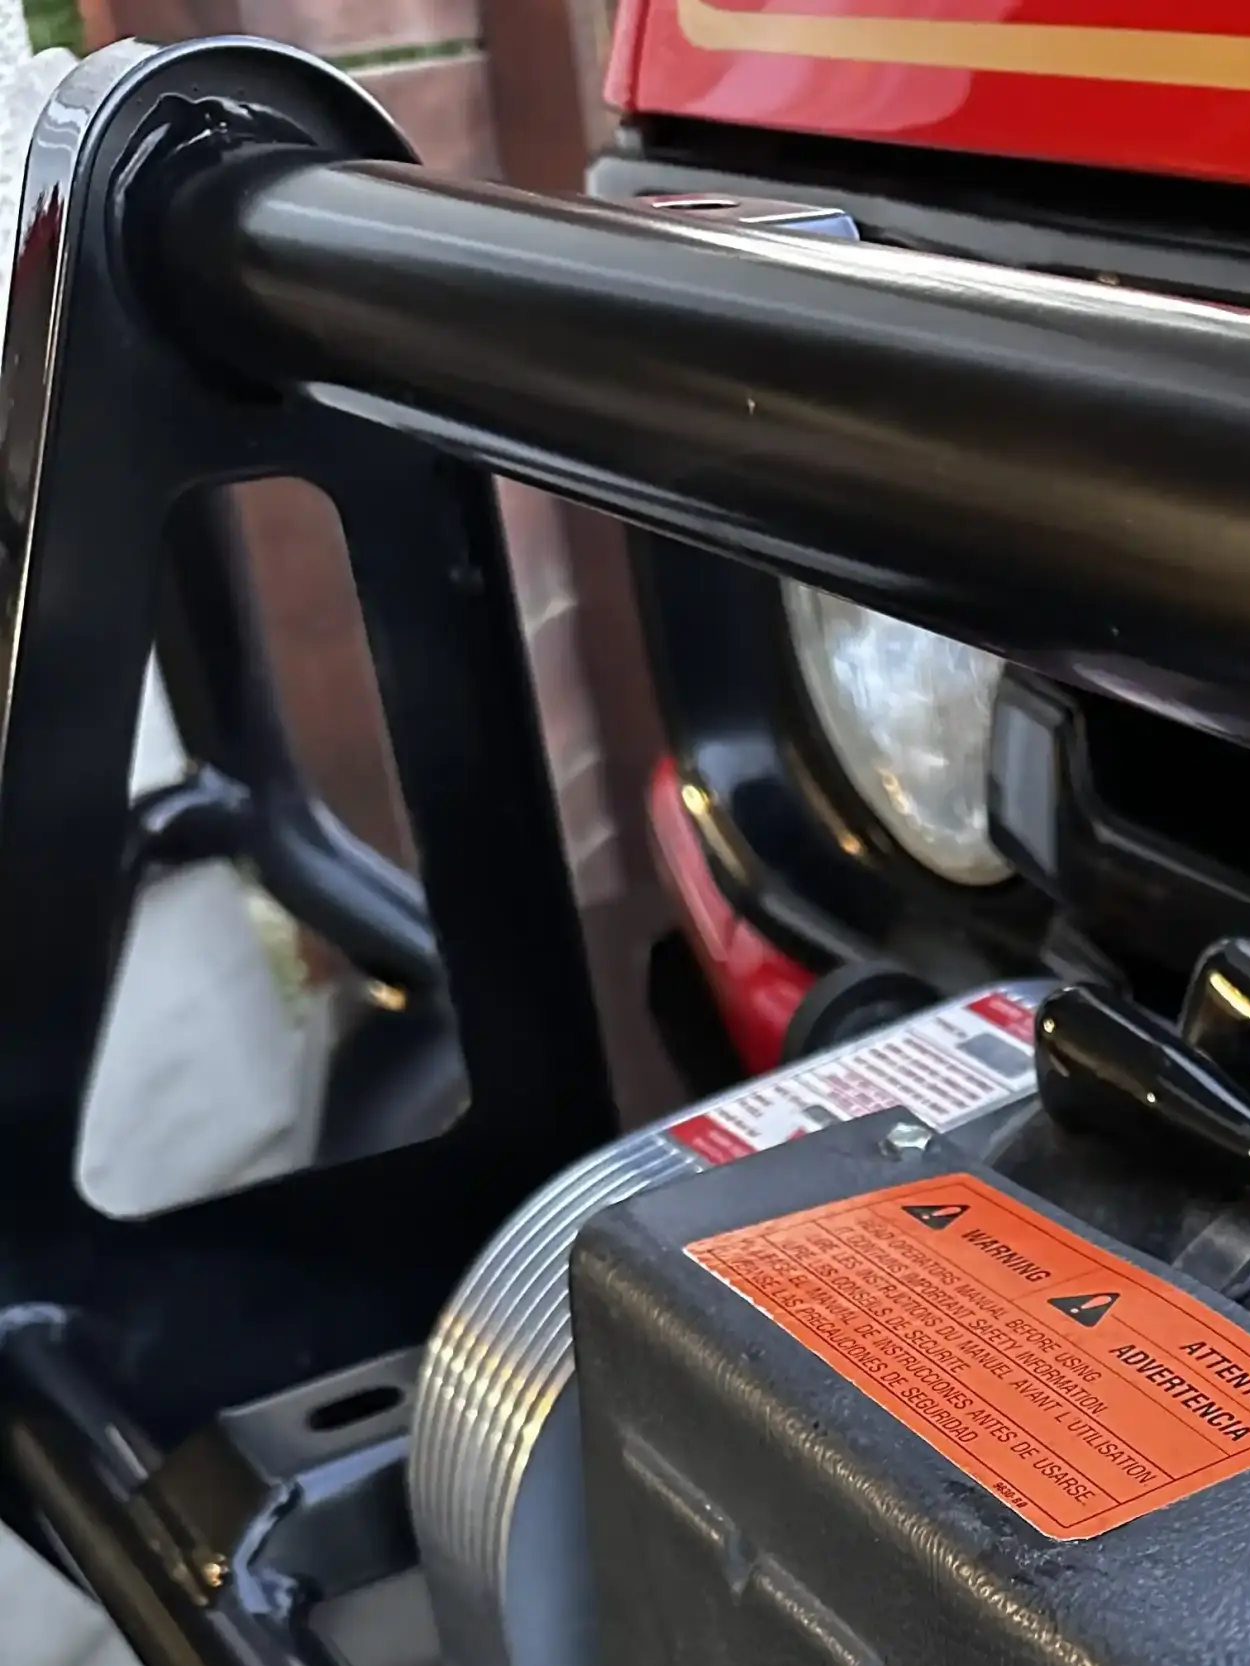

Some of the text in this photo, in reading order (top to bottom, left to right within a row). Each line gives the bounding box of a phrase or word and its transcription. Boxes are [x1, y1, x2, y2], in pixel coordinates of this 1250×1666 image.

[807, 1260, 838, 1277] LES
[831, 1276, 893, 1317] CONSEILS
[886, 1316, 910, 1329] DE
[831, 1252, 863, 1269] LES
[936, 1326, 962, 1340] DU
[957, 1341, 1015, 1378] MANUEL
[1010, 1379, 1061, 1412] AVANT
[847, 1235, 908, 1272] CONTAINS
[901, 1272, 974, 1318] IMPORTANT
[968, 1319, 1020, 1351] SAFETY
[1015, 1351, 1110, 1415] INFORMATION.
[888, 1240, 960, 1284] OPERATORS
[954, 1284, 1010, 1318] MANUAL
[1007, 1319, 1059, 1352] BEFORE
[1054, 1352, 1101, 1381] USING
[960, 1229, 1052, 1281] WARNING
[772, 1288, 803, 1307] LAS
[796, 1307, 888, 1372] PRECAUCIONES
[881, 1372, 906, 1386] DE
[901, 1387, 977, 1442] SEGURIDAD
[788, 1275, 812, 1287] EL
[806, 1287, 862, 1324] MANUAL
[854, 1324, 879, 1337] DE
[873, 1338, 973, 1408] INSTRUCCIONES
[968, 1408, 1016, 1441] ANTES
[1011, 1442, 1037, 1457] DE
[1033, 1458, 1097, 1504] USARSE.
